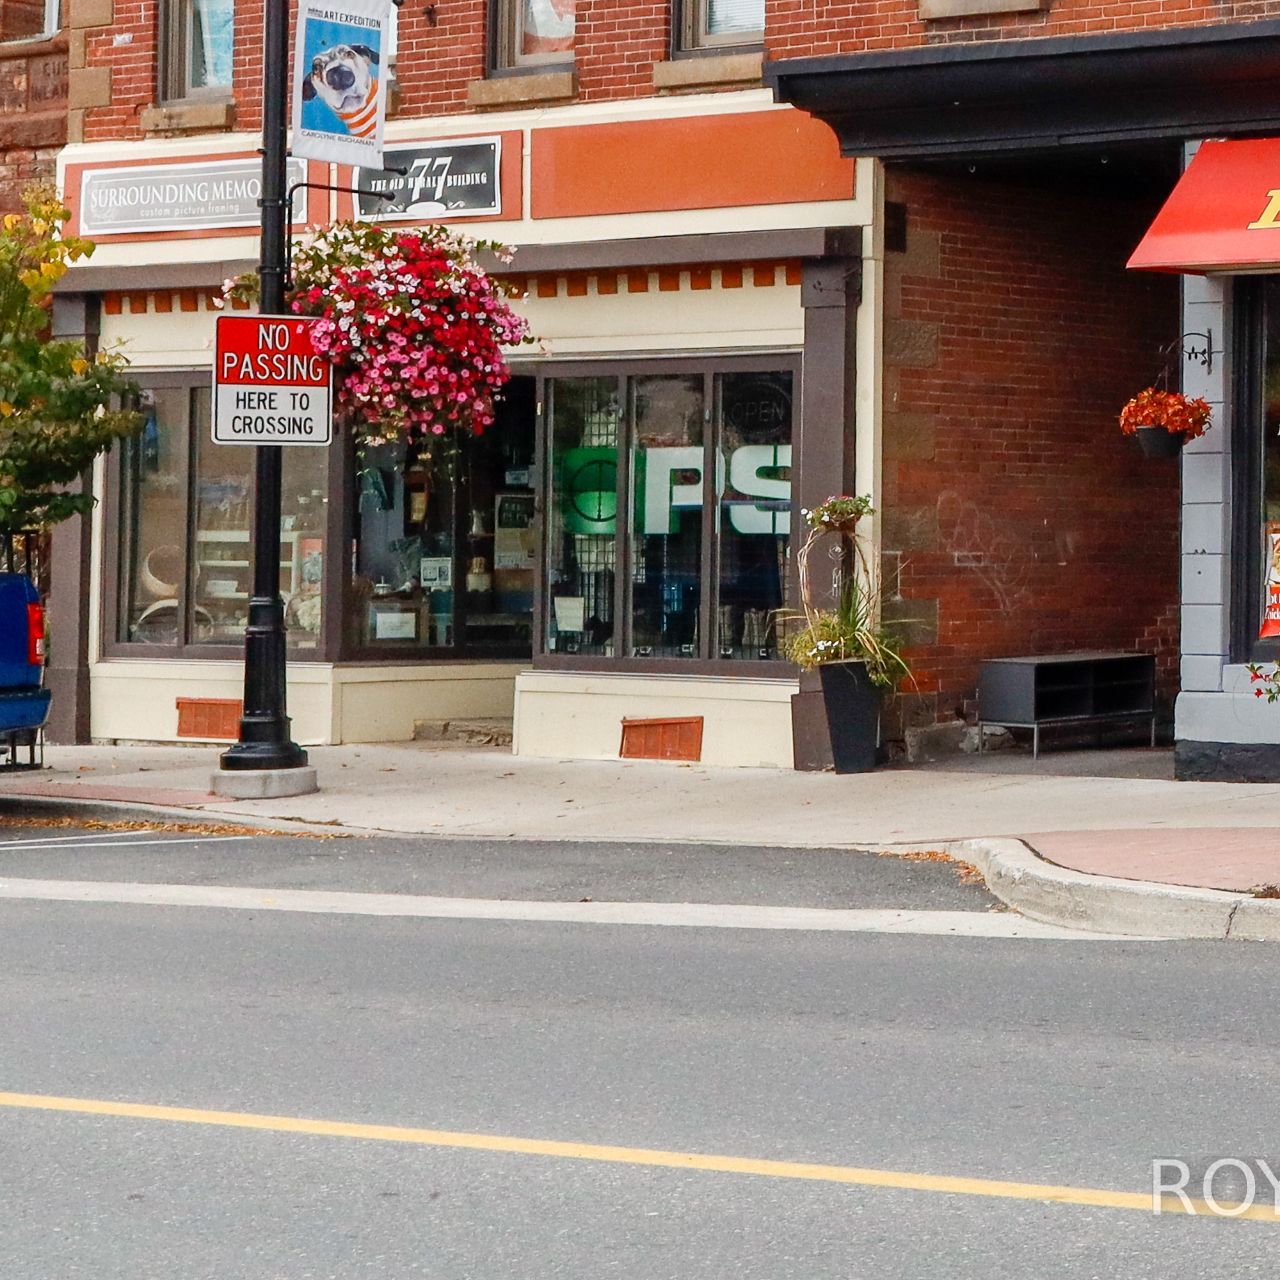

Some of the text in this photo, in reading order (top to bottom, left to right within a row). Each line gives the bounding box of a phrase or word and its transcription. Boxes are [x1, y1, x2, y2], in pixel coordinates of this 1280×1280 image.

[324, 10, 338, 20] ART
[340, 13, 381, 28] EXPEDITION
[371, 179, 387, 191] THE
[389, 178, 404, 190] OLD
[447, 172, 487, 187] BUILDING
[409, 156, 453, 202] 77
[90, 176, 297, 209] SURROUNDING MEMOS
[139, 202, 239, 217] custom picture framing
[258, 324, 290, 350] NO
[223, 352, 323, 381] PASSING
[236, 392, 310, 411] HERE TO
[232, 415, 313, 435] CROSSING
